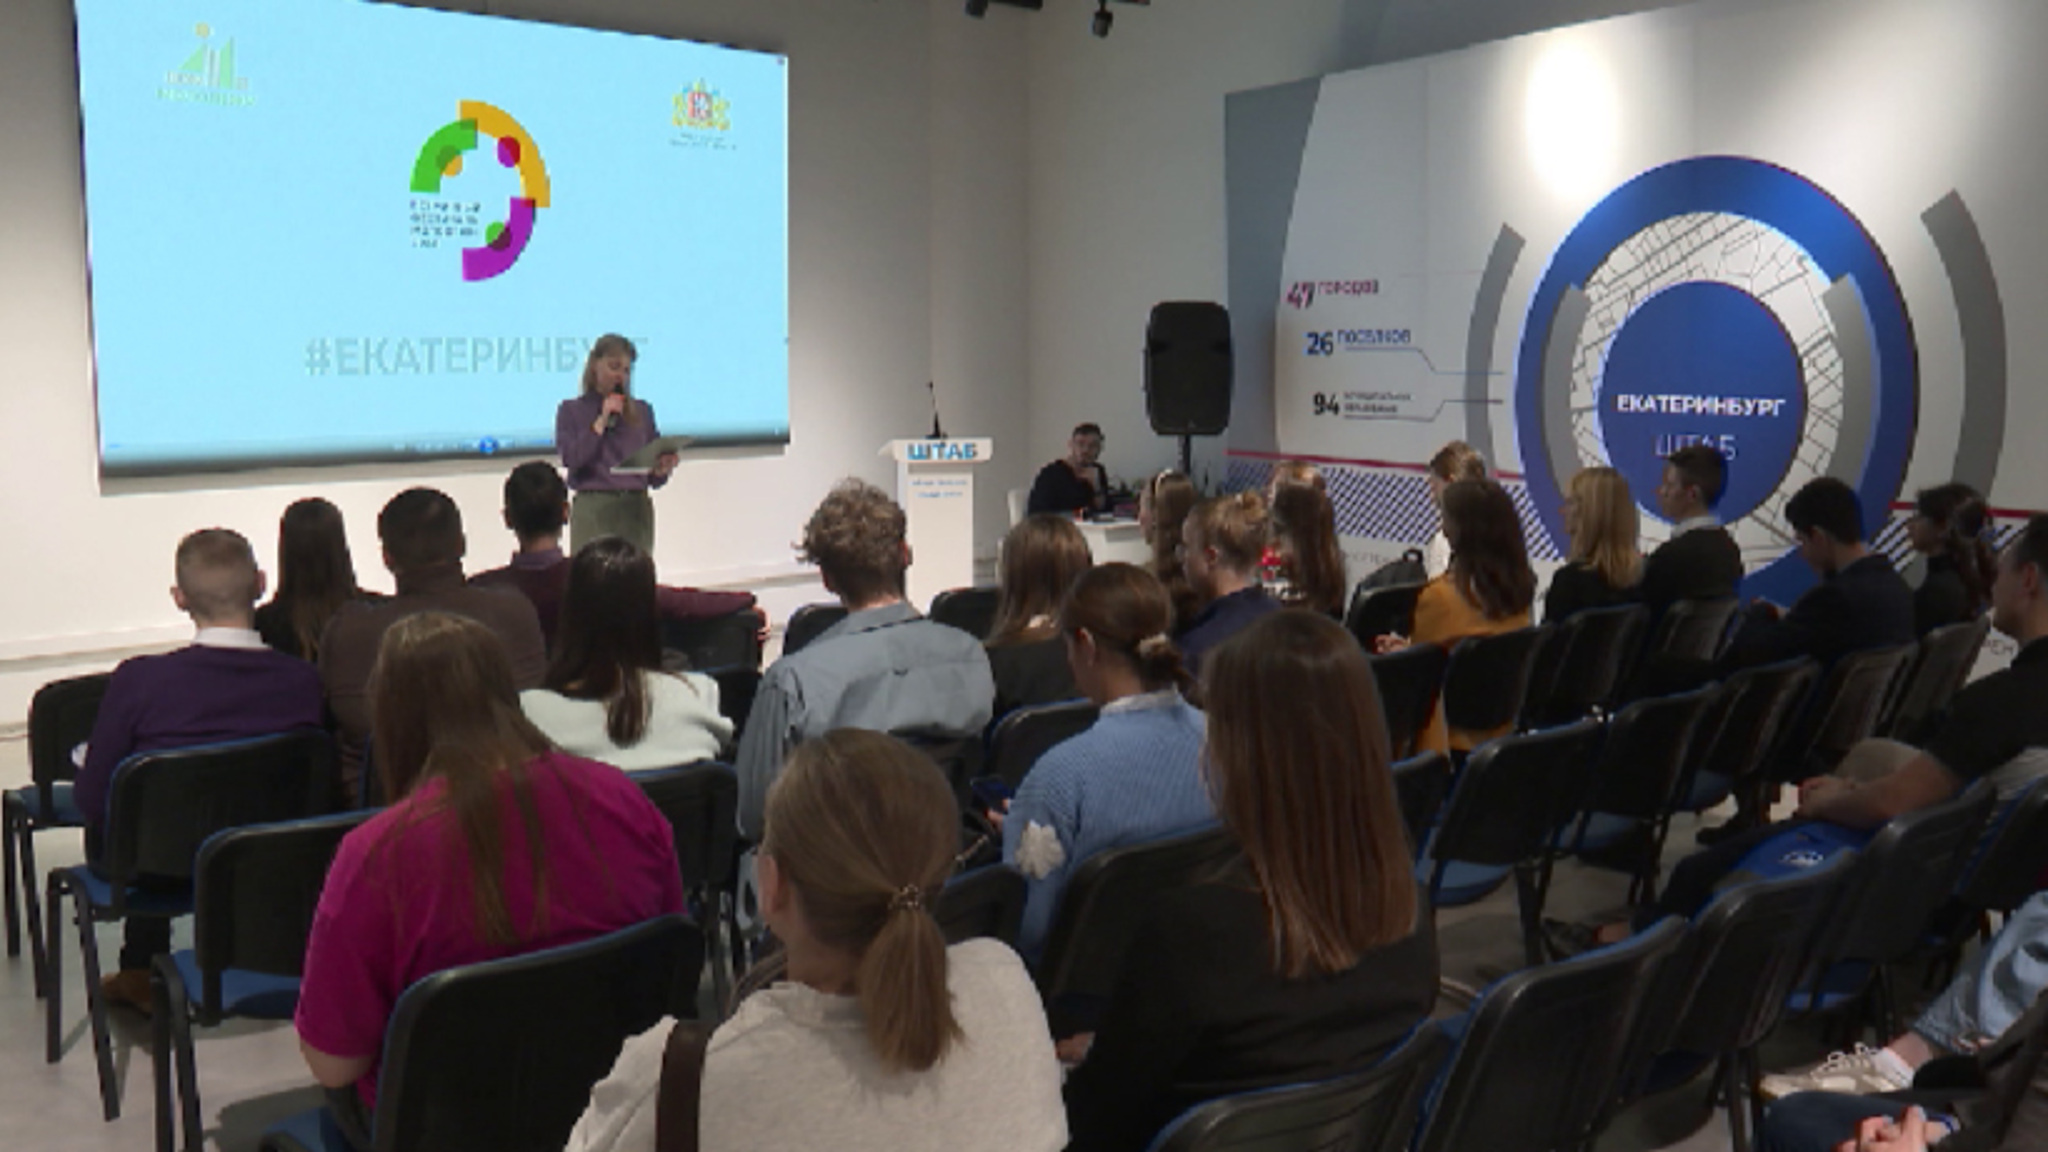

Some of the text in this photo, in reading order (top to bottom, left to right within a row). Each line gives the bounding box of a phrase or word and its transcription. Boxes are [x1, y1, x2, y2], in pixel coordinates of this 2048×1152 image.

[1286, 281, 1315, 309] 47
[304, 336, 649, 376] #ЕКАТЕРИНБ
[1303, 331, 1334, 356] 26
[1313, 391, 1339, 416] 94
[1616, 393, 1787, 417] ЕКАТЕРИНБУРГ
[907, 442, 977, 460] ШТАБ
